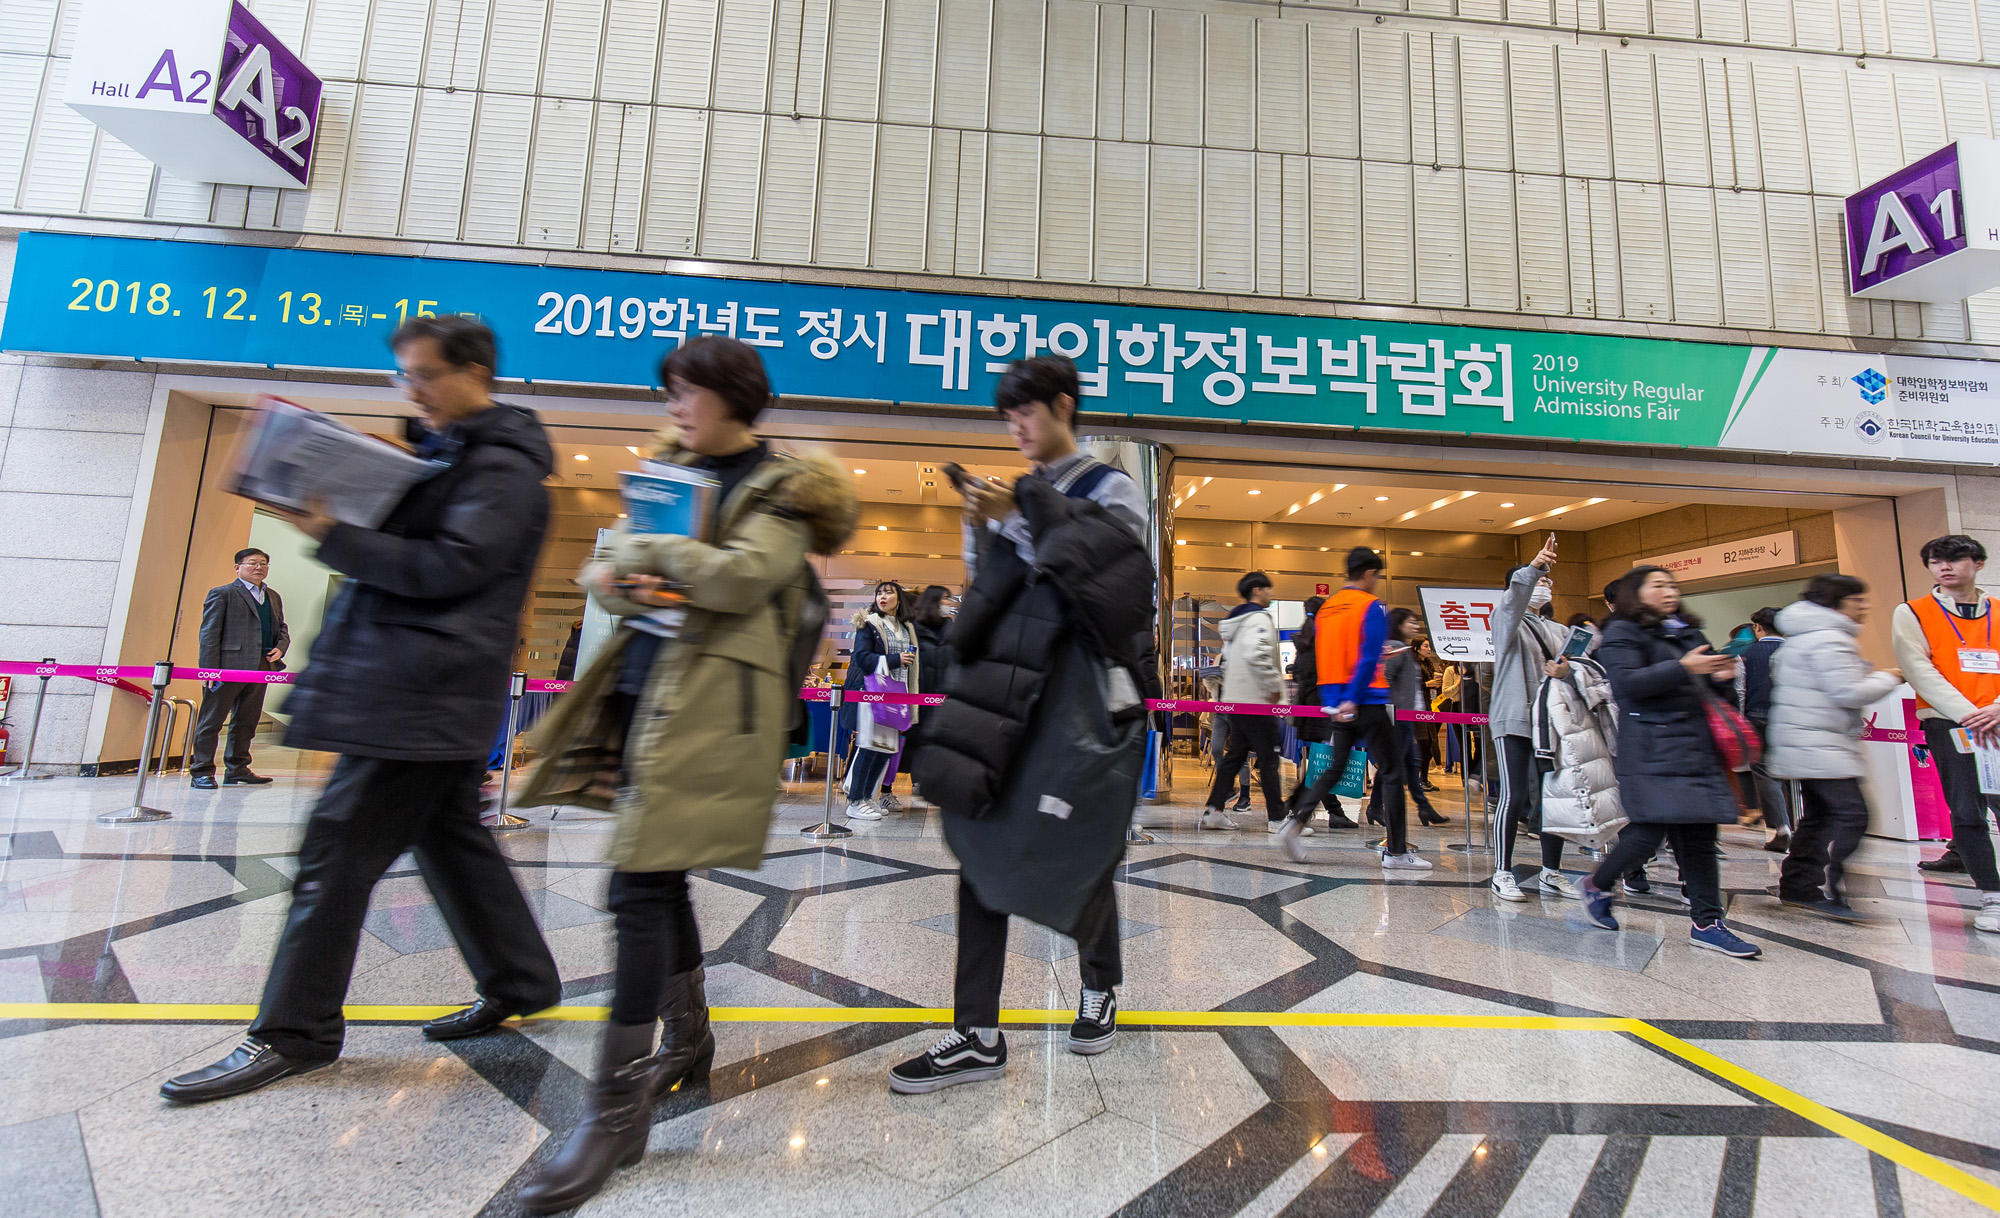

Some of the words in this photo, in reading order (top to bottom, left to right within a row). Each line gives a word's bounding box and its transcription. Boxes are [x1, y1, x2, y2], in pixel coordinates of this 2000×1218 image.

[91, 81, 129, 98] Hall
[135, 49, 212, 104] A2
[218, 43, 311, 167] A2
[1860, 188, 1957, 276] A1
[67, 277, 182, 317] 2018.
[202, 286, 257, 321] 12.
[534, 291, 784, 350] 2019학년도
[796, 307, 887, 364] 정시
[906, 308, 1514, 422] 대학입학정보박람회
[1532, 354, 1579, 373] 2019
[1533, 375, 1628, 400] University
[1633, 380, 1704, 403] Regular
[1896, 376, 1988, 392] 대학입학정보박람회
[1898, 390, 1949, 403] 준비위원회
[1534, 396, 1642, 419] Admissions
[1647, 402, 1680, 421] Fair
[1887, 418, 2000, 436] 한국대학교육협의회
[1889, 432, 1909, 440] Korean
[1910, 432, 1931, 441] Council
[1942, 434, 1970, 444] University
[1971, 436, 1999, 445] Education
[1723, 551, 1738, 564] B2
[1440, 600, 1494, 631] 출구
[36, 666, 58, 674] coex
[96, 666, 119, 675] coex
[198, 671, 223, 679] coex
[264, 674, 289, 682] coex
[544, 682, 567, 690] coex
[862, 693, 885, 702] coex
[924, 696, 945, 704] coex
[1156, 701, 1177, 709] coex
[1214, 704, 1235, 712] coex
[1271, 706, 1292, 714] coex
[1888, 731, 1908, 740] coex
